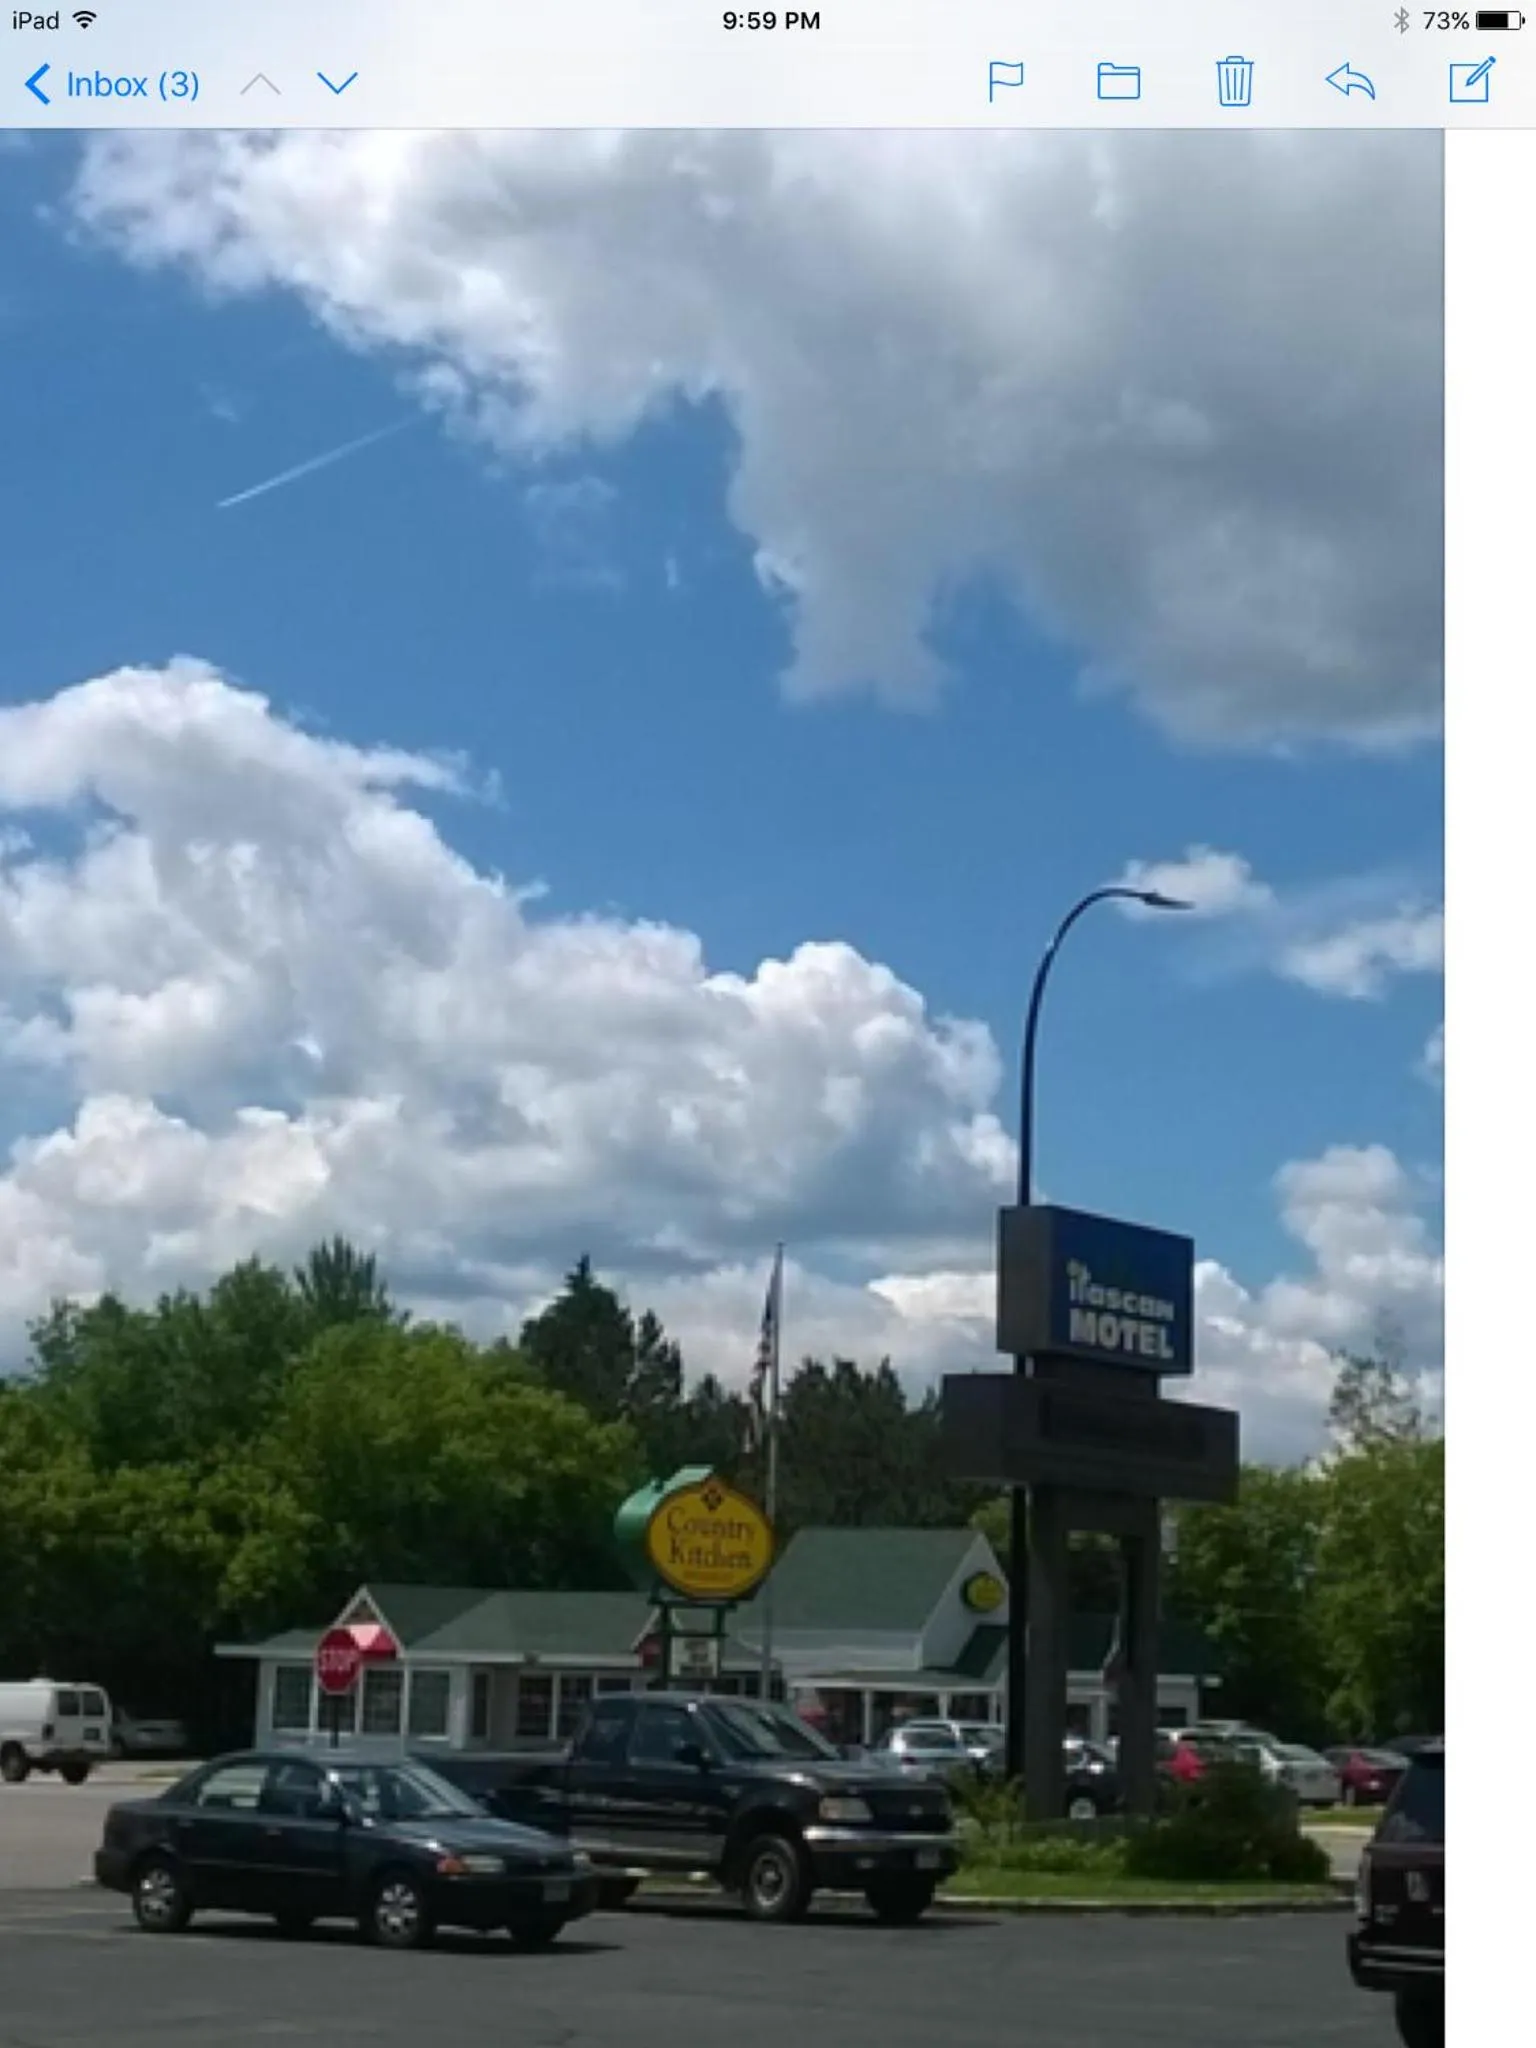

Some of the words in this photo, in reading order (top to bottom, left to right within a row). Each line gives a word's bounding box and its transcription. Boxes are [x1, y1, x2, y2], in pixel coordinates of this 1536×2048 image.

[1070, 1308, 1174, 1359] MOTEL
[667, 1505, 756, 1544] Country
[668, 1536, 752, 1569] Kitchen
[320, 1648, 359, 1672] STOP
